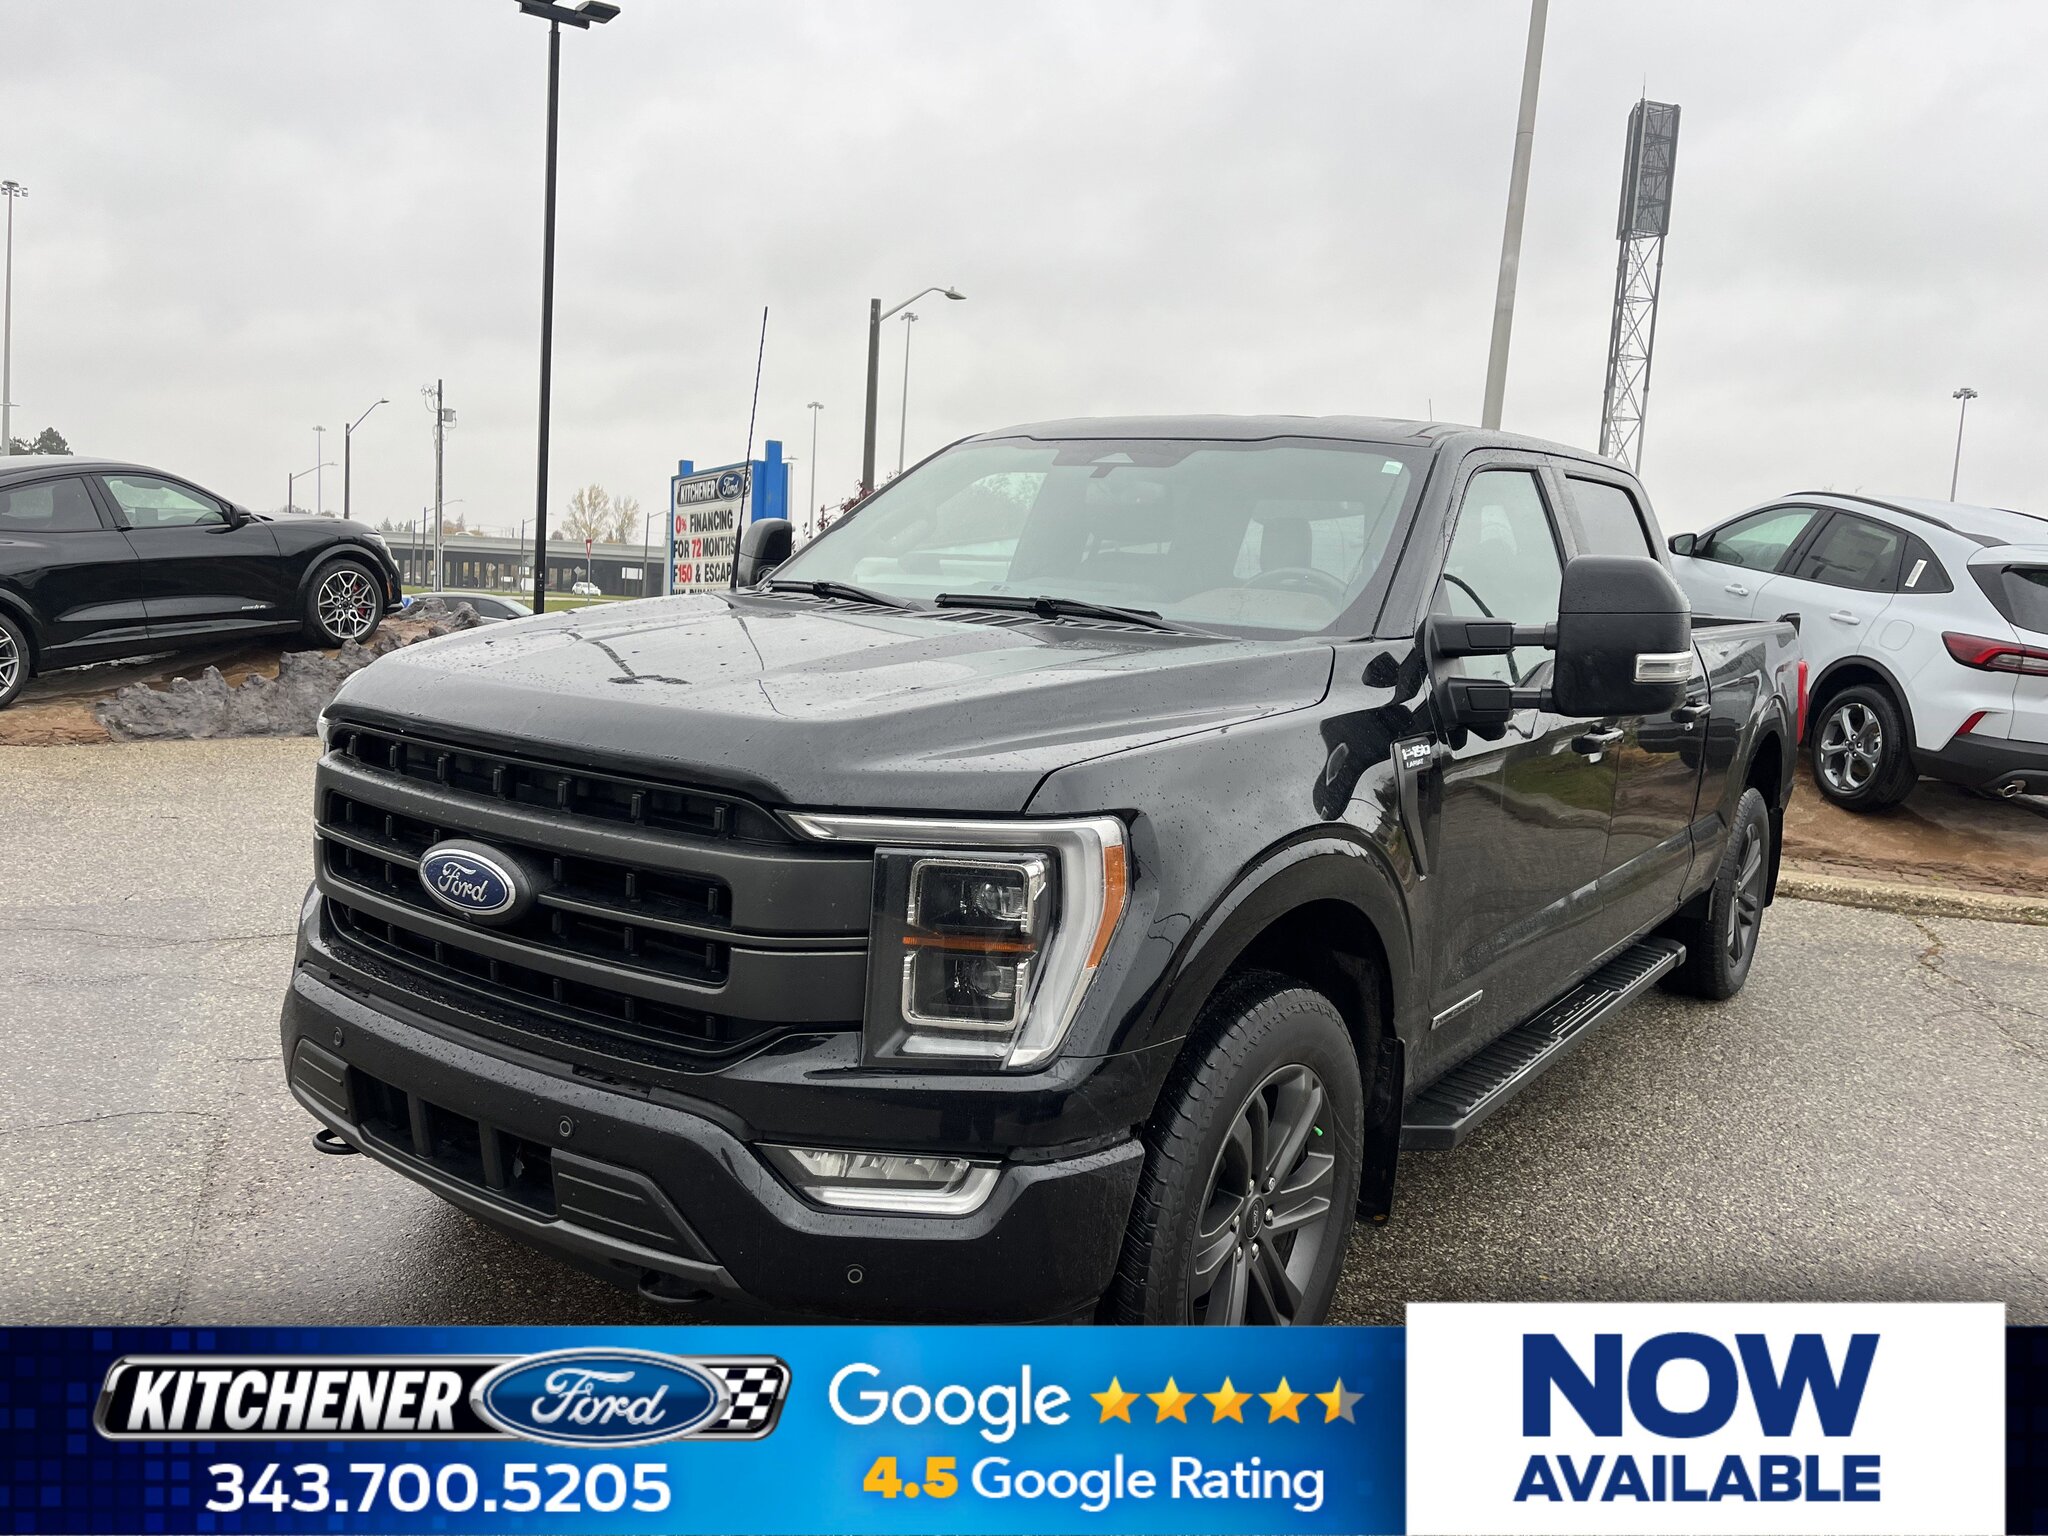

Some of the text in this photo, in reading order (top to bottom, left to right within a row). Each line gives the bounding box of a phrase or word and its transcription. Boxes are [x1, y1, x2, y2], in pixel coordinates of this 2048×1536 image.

[680, 476, 739, 504] KITCHENER Ford
[675, 509, 733, 534] 0% FINANCING
[673, 536, 736, 559] FOR 72 MONTHS
[672, 562, 732, 583] F150 & ESCAP
[437, 861, 489, 903] Ford
